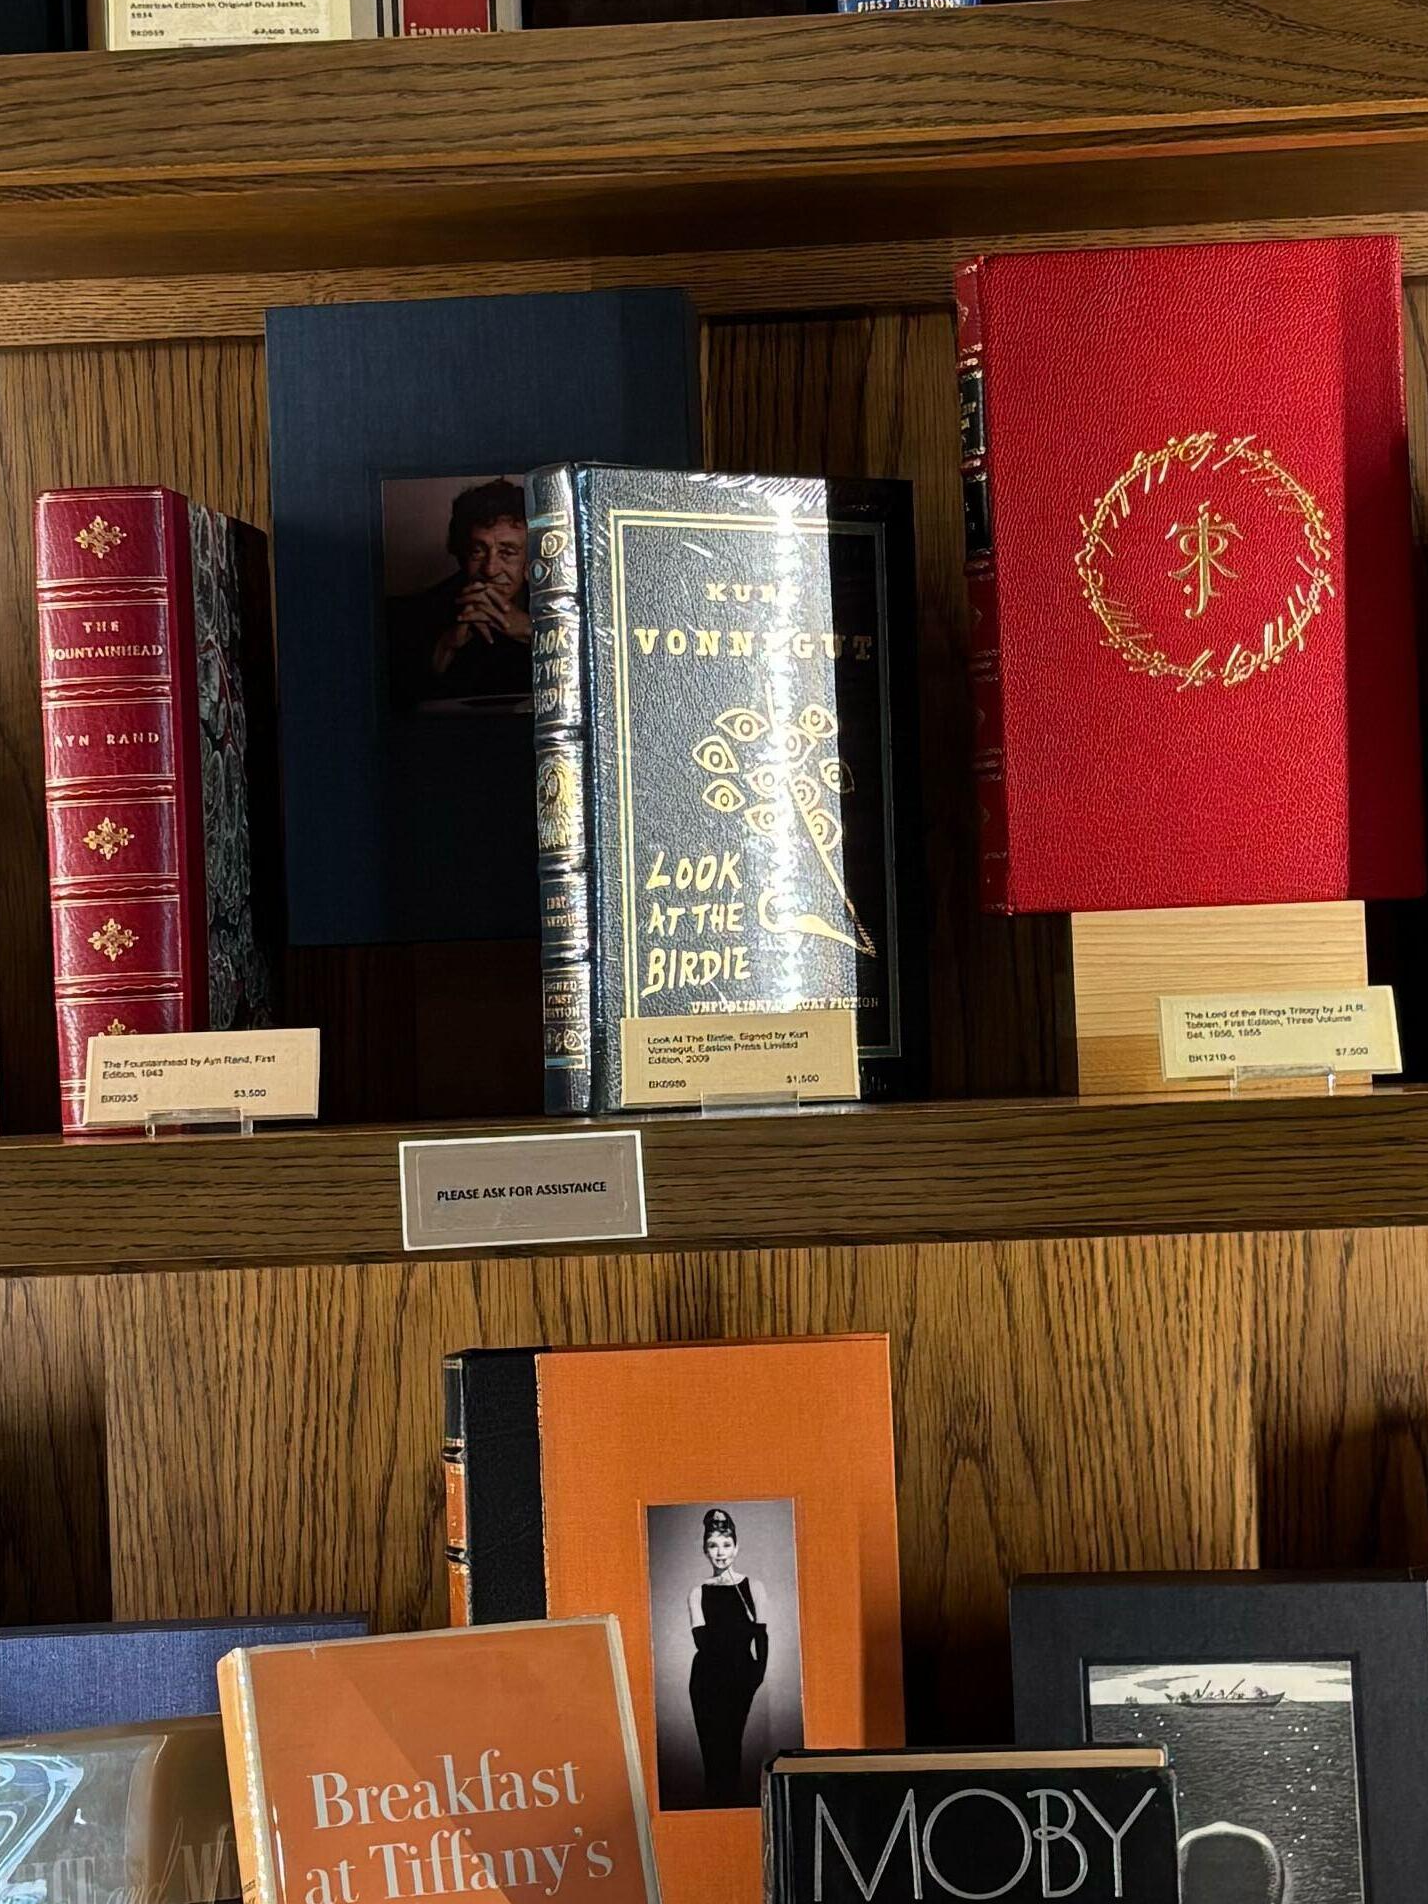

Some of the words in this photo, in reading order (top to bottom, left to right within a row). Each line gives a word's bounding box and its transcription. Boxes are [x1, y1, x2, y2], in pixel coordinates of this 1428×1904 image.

[82, 621, 120, 634] THE
[633, 627, 873, 661] VONNEGUT
[49, 643, 163, 660] FOUNTAINHEAD
[53, 732, 90, 747] AYN
[105, 731, 160, 746] RAND
[646, 850, 741, 890] LOOK
[647, 903, 684, 936] AT
[691, 901, 744, 932] THE
[641, 944, 751, 996] BIRDIE
[104, 1061, 121, 1069] The
[191, 1058, 201, 1067] by
[437, 1188, 479, 1201] PLEASE
[483, 1187, 505, 1198] ASK
[509, 1186, 533, 1196] FOR
[536, 1181, 606, 1195] ASSISTANCE
[307, 1748, 584, 1830] Breakfast
[814, 1787, 1158, 1902] MOBY
[370, 1825, 614, 1902] Tiffany's
